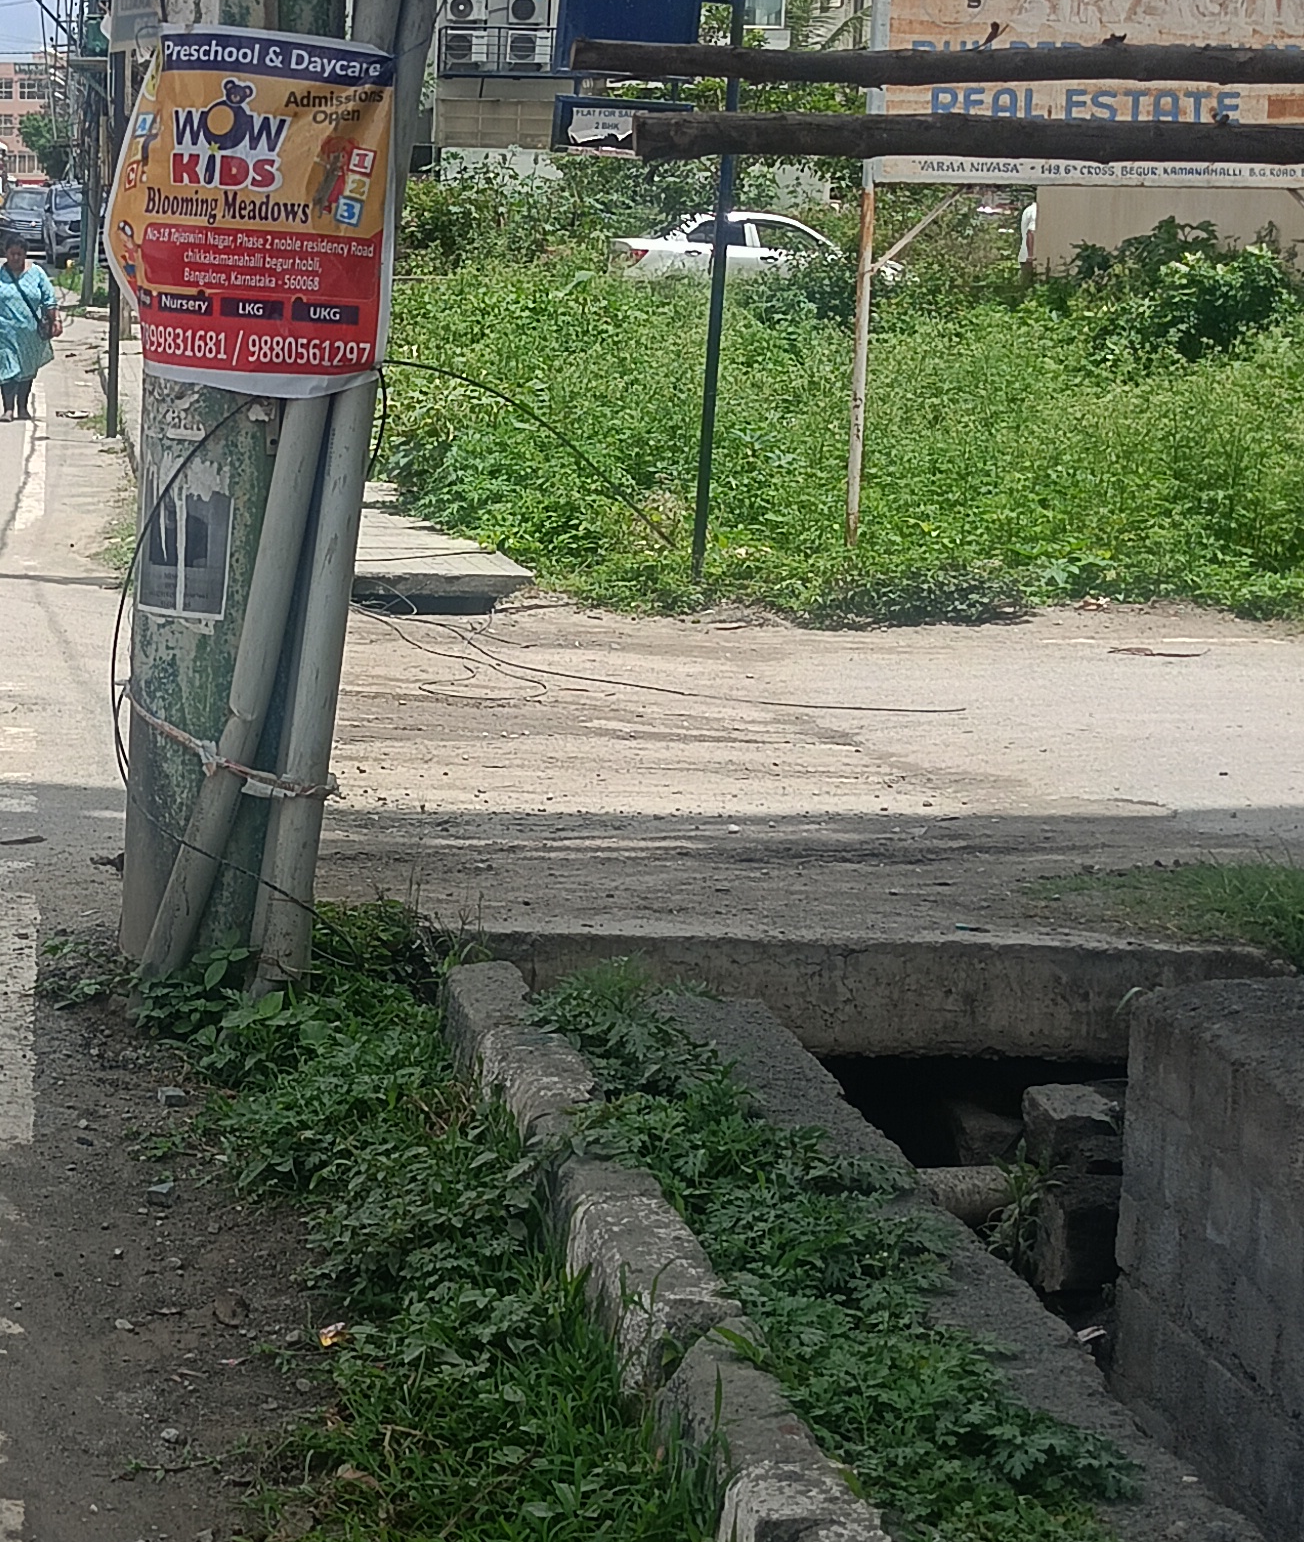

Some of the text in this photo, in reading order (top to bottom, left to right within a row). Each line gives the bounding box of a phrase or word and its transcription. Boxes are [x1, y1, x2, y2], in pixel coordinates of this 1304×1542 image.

[164, 40, 381, 78] Preschool & Daycare
[284, 88, 384, 109] Admissions
[1064, 88, 1241, 126] ESTATE
[312, 108, 361, 126] Open
[576, 109, 635, 118] FLAT FOR SAL
[174, 104, 287, 153] WOW
[594, 121, 620, 131] 2 BHK
[172, 150, 276, 188] KIDS
[143, 185, 311, 225] Blooming Meadows
[146, 227, 375, 258] No-18 Tejaswini Nagar, Phase 2 noble residency Road
[265, 253, 294, 273] begur
[295, 255, 323, 274] hobli,
[183, 267, 229, 287] Bangalore,
[230, 270, 276, 289] Karnataka
[283, 274, 320, 291] 560068
[161, 294, 209, 314] Nursery
[238, 301, 264, 316] LKG
[309, 305, 341, 321] UKG
[247, 334, 371, 367] 9880561297
